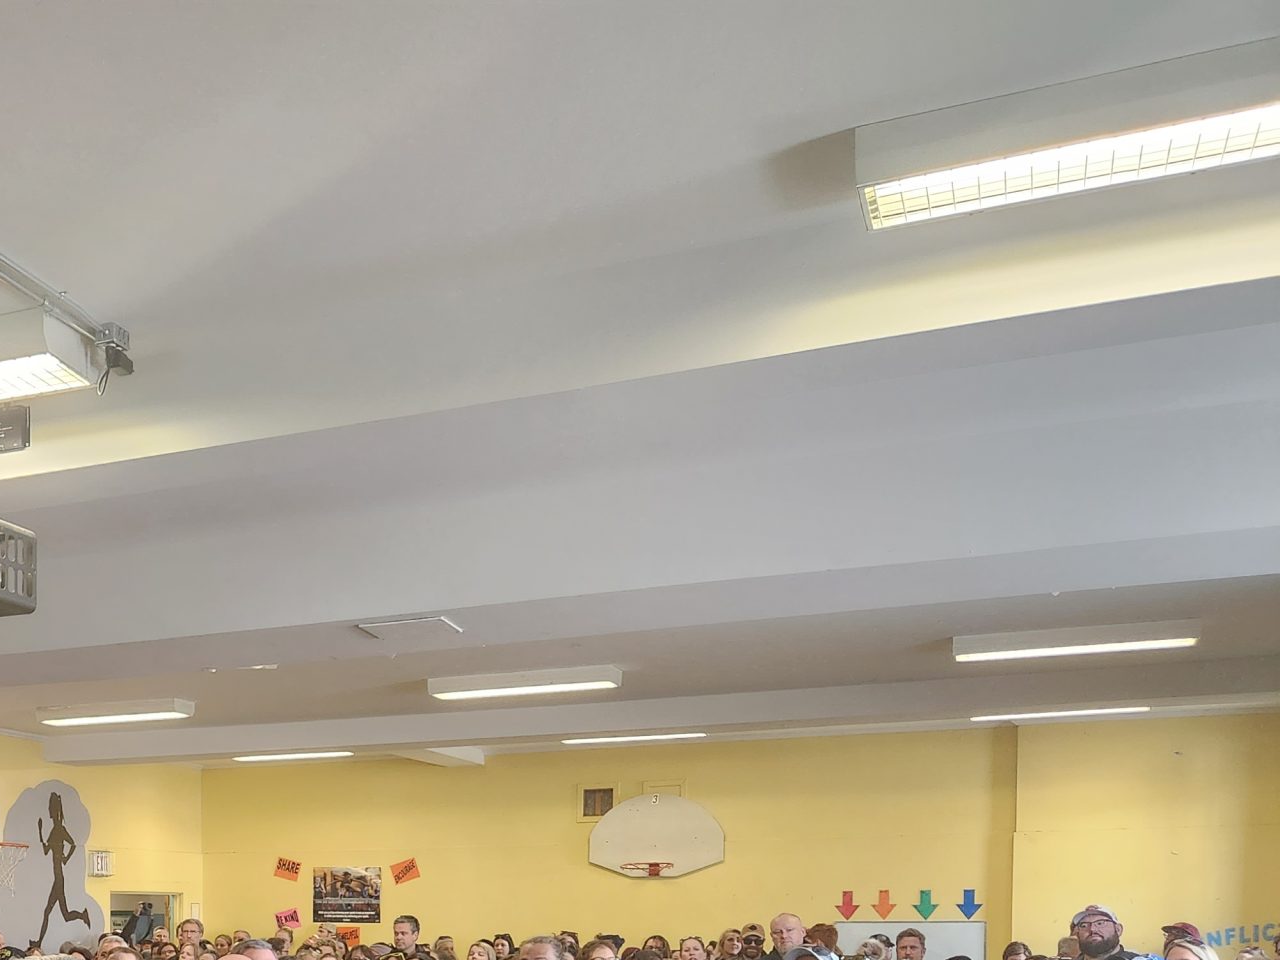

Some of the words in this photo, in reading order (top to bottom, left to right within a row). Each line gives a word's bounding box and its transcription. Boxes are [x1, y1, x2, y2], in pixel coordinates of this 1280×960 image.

[652, 794, 659, 804] 3
[96, 855, 109, 872] EXIT
[276, 858, 301, 874] SHARE
[394, 858, 416, 884] ENCOURAGE
[284, 910, 299, 923] KIND
[1202, 922, 1280, 946] NFLIC
